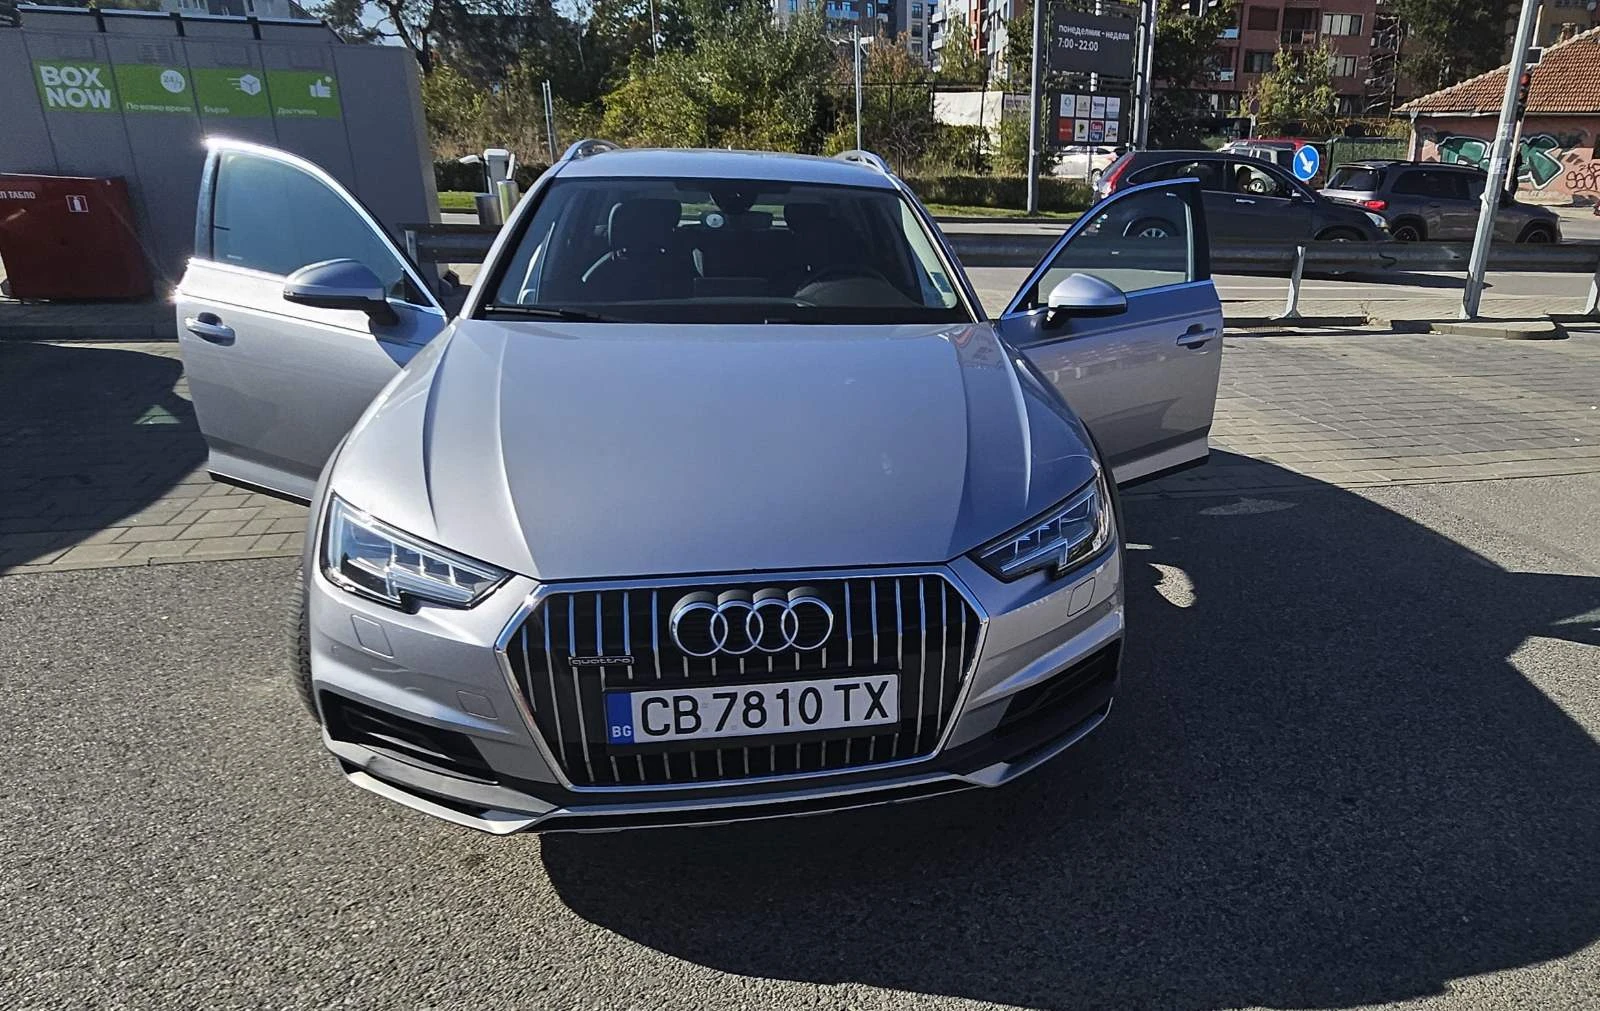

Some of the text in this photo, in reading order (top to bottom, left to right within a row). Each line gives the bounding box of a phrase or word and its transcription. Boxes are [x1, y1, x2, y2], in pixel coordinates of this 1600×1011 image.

[1058, 24, 1101, 37] понеделник
[1105, 31, 1130, 40] неделя
[1058, 37, 1074, 49] 7:00
[1078, 40, 1099, 52] 22:00
[40, 65, 105, 88] BOX
[45, 87, 111, 109] NOW
[8, 191, 36, 200] ТАБЛО
[572, 657, 631, 666] quattro
[641, 680, 889, 736] CB 7810 TX
[612, 725, 632, 738] BG
